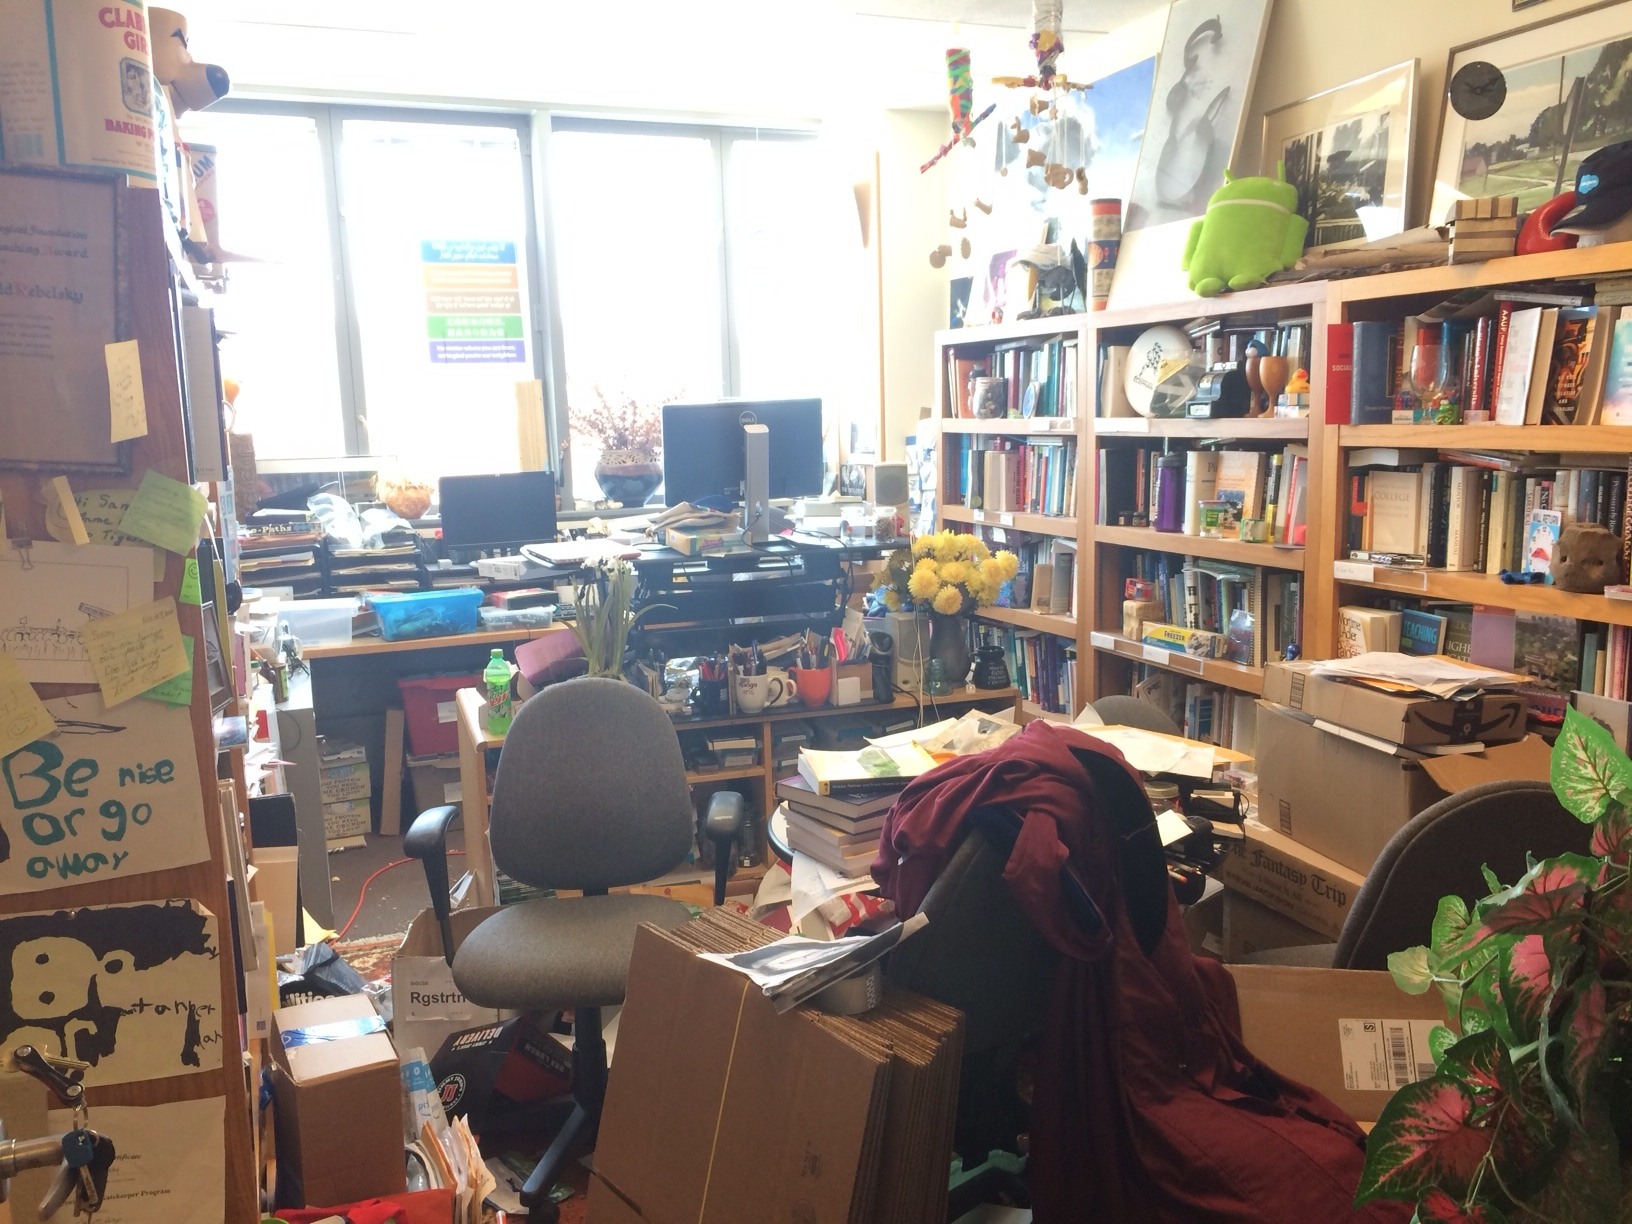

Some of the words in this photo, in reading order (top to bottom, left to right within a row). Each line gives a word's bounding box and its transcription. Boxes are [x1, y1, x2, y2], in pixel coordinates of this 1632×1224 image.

[98, 7, 146, 28] CLAB
[105, 118, 147, 139] BAKING
[14, 280, 84, 304] Rebelsky
[1501, 309, 1509, 332] AAUP
[1373, 490, 1411, 502] COLLEGE
[1542, 513, 1559, 526] RETURN
[1163, 630, 1185, 641] FREEZER
[1403, 620, 1438, 644] TEACHING
[2, 739, 99, 810] Be
[118, 758, 175, 787] nise
[22, 807, 85, 846] or
[99, 799, 153, 842] go
[26, 851, 129, 880] away
[1250, 848, 1308, 887] Fantasy
[1310, 873, 1347, 908] Trip
[410, 991, 467, 1007] Rgstrtn
[452, 1026, 504, 1047] DELIVERY
[140, 1188, 171, 1198] Program
